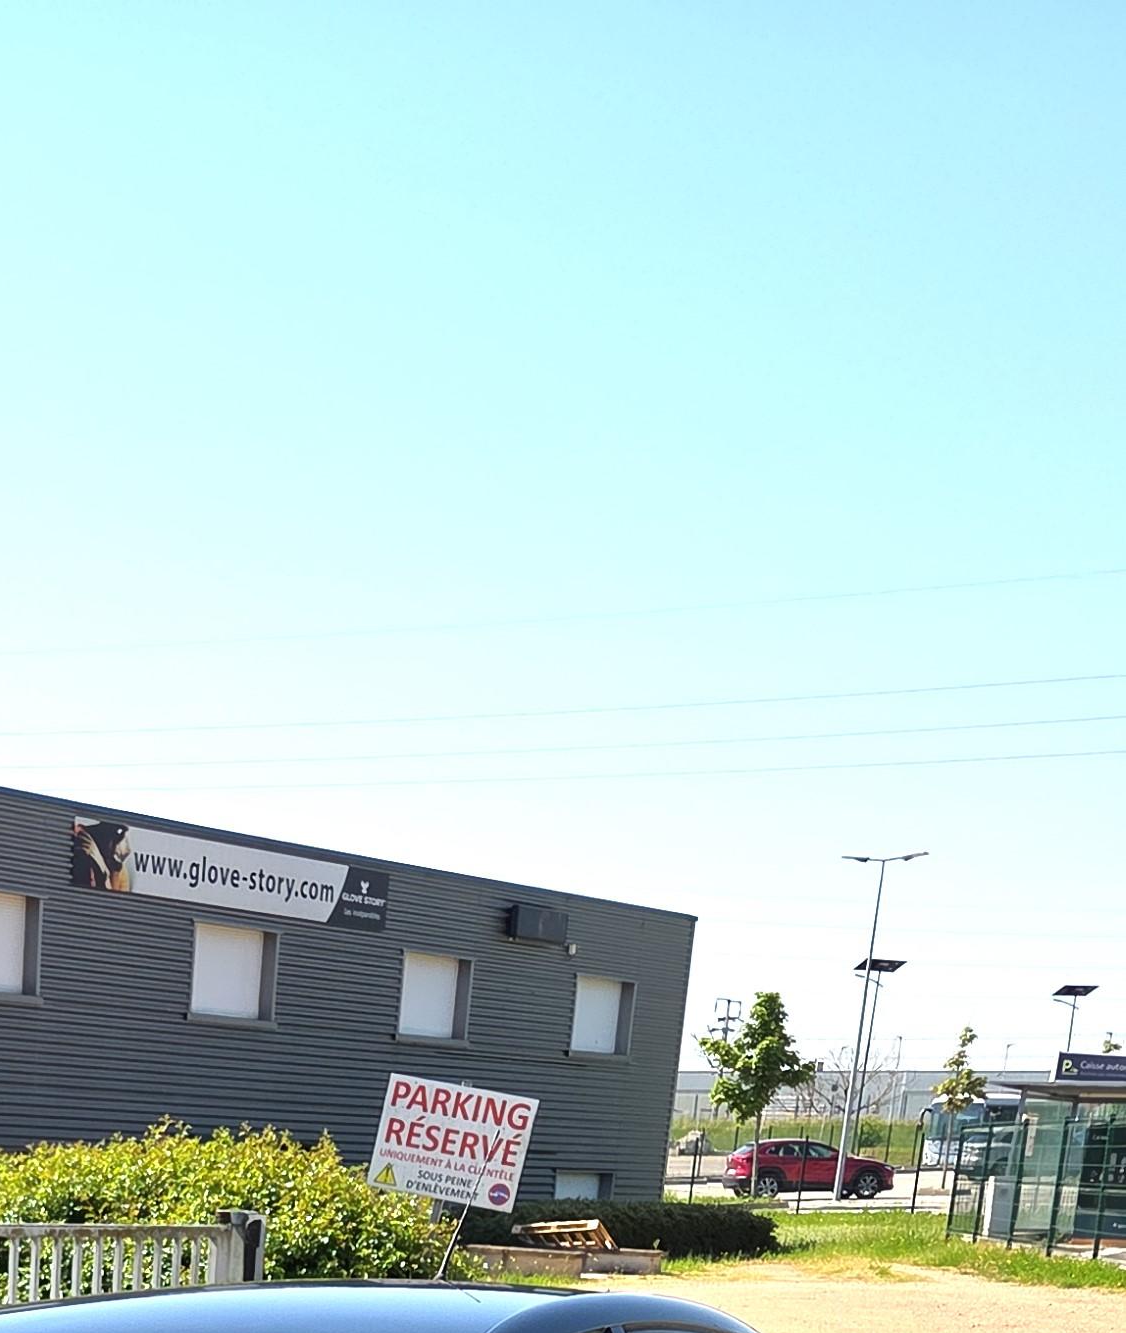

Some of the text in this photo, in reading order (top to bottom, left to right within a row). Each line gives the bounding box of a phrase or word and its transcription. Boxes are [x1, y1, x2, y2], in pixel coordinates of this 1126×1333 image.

[134, 852, 335, 904] www.glove-story.com
[390, 1080, 531, 1131] PARKING
[379, 1148, 515, 1182] UNIQUEMENT À LA CLINTÈLE
[384, 1116, 523, 1168] RÉSERVÉ
[417, 1169, 473, 1188] SOUS PEINE
